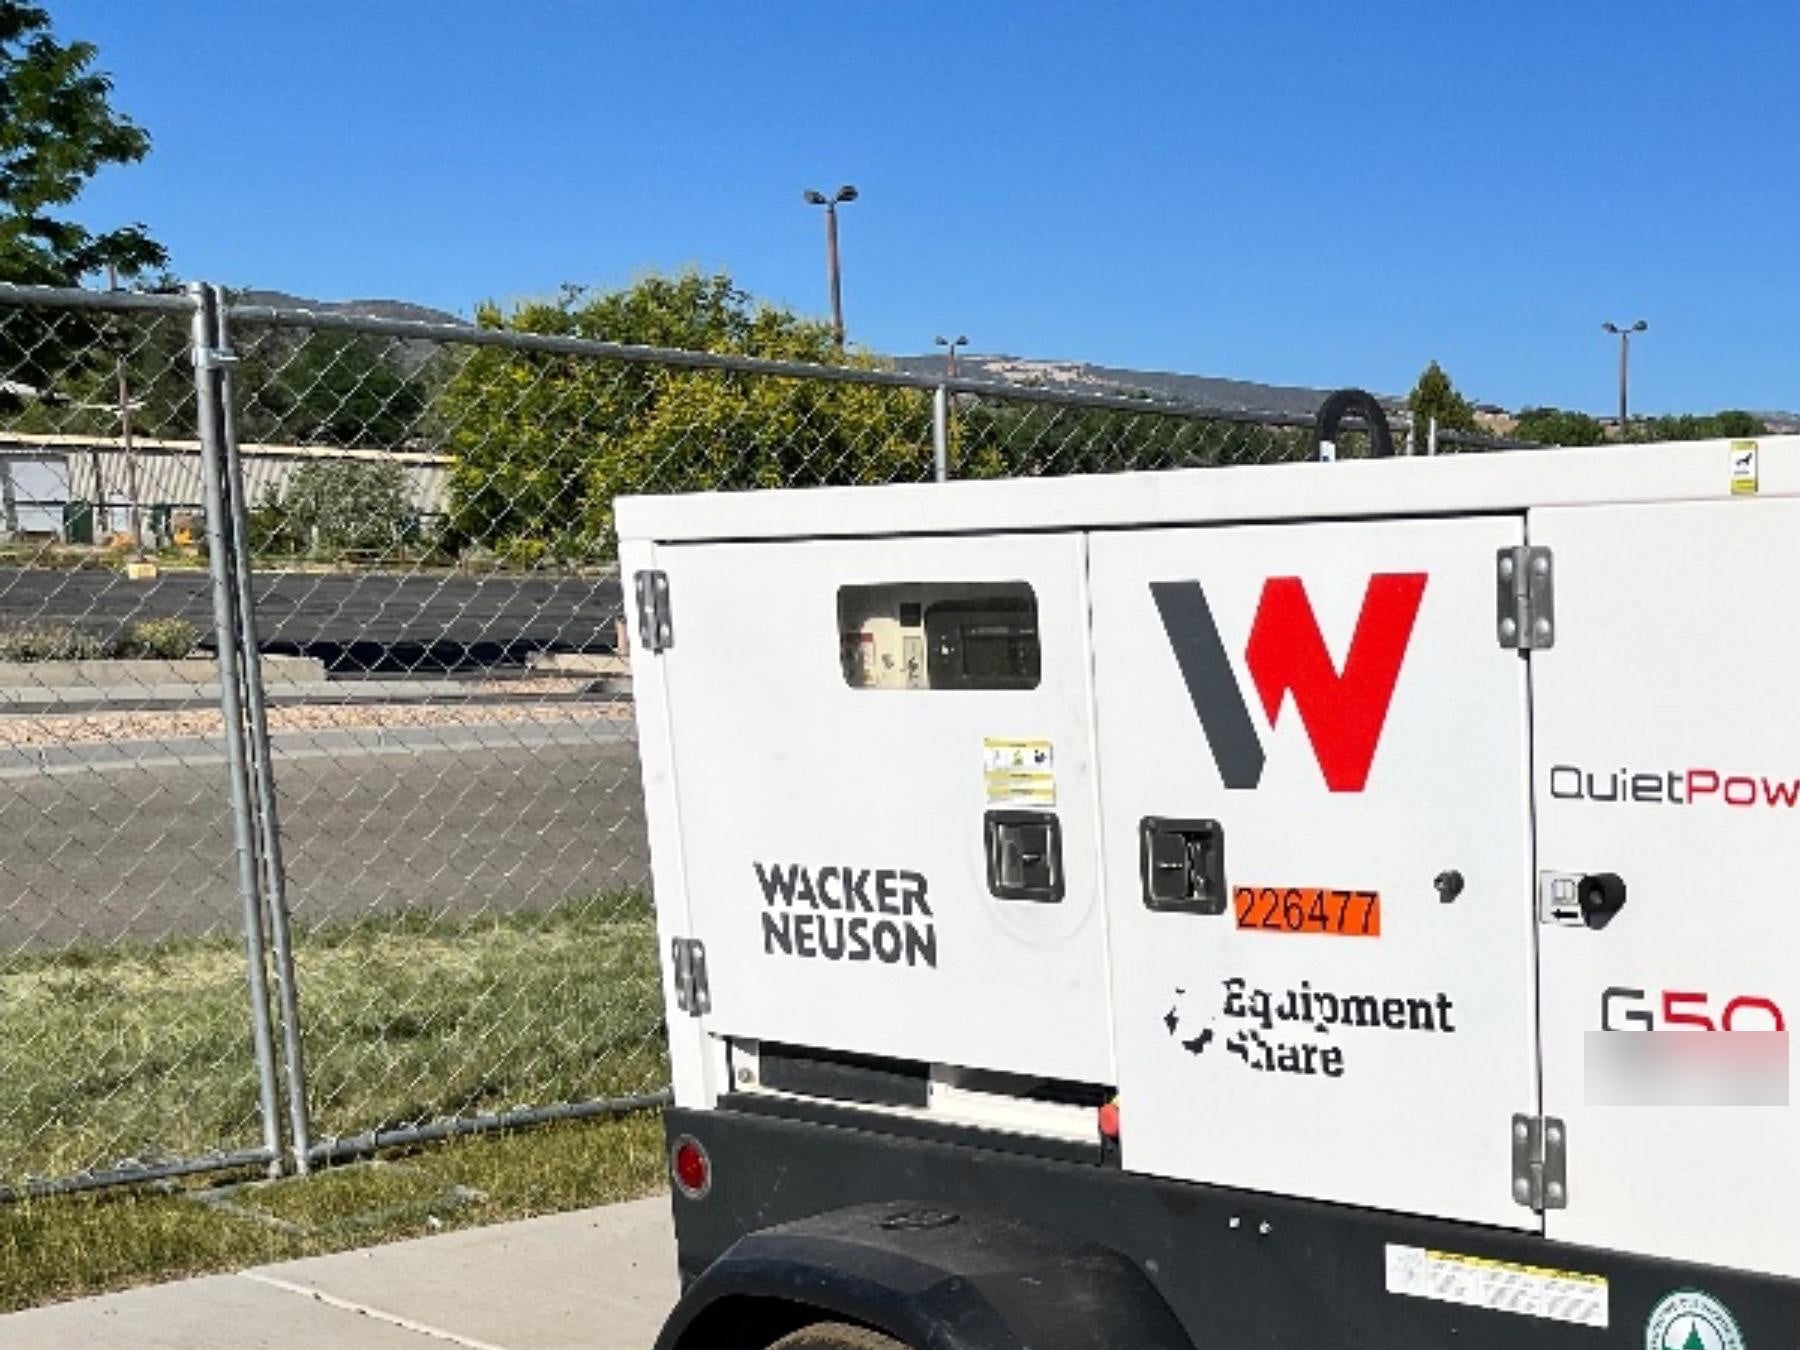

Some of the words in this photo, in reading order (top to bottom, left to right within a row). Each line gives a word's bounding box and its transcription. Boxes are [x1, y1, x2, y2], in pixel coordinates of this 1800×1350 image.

[753, 861, 934, 918] WACKER
[1236, 887, 1380, 934] 226477
[761, 911, 937, 969] NEUSON
[1222, 977, 1456, 1034] Equipment
